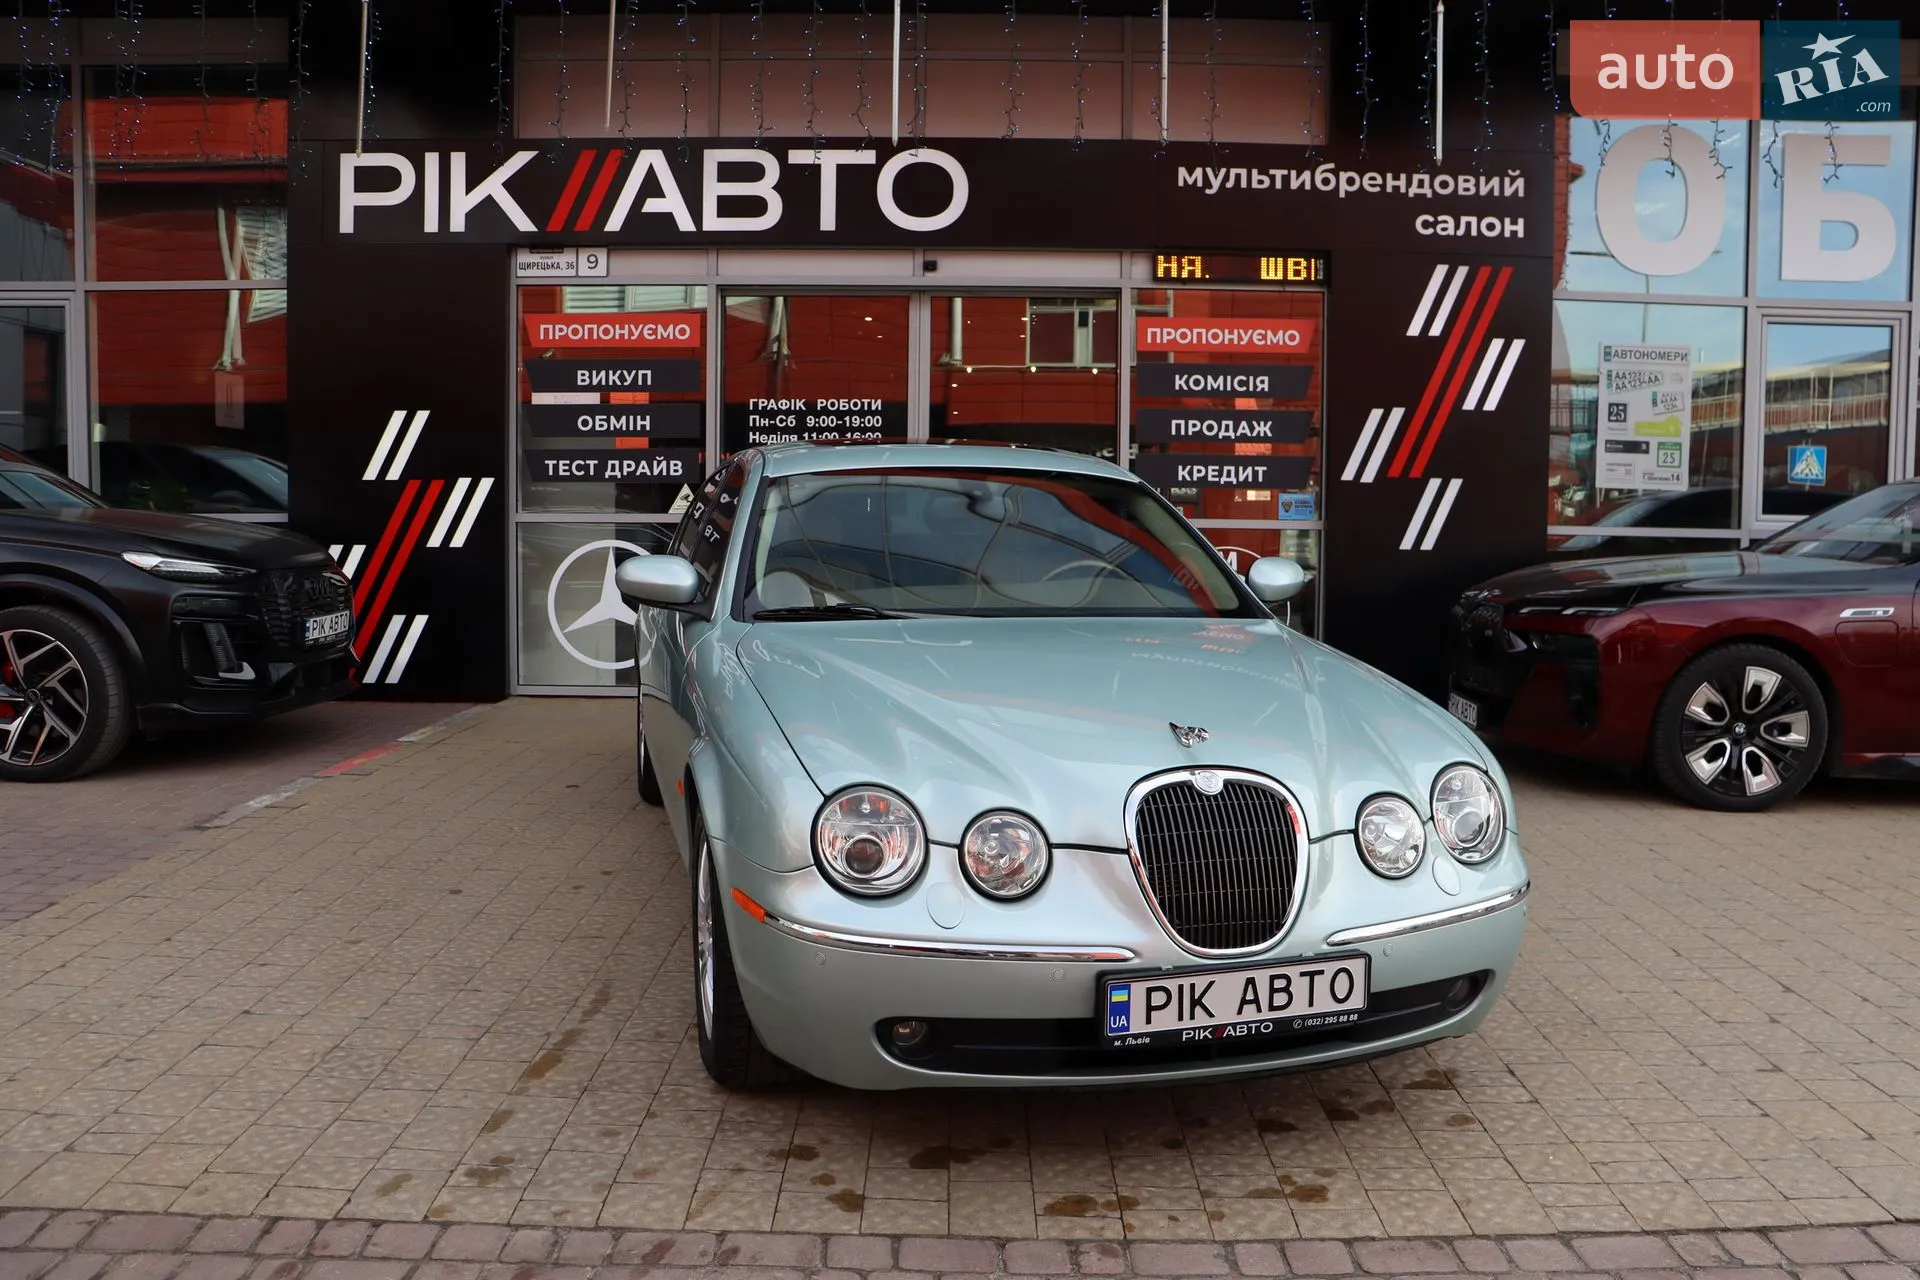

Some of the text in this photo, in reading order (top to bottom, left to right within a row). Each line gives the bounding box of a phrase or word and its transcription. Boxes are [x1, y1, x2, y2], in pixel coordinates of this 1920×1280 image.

[1177, 162, 1525, 198] мультибрендовий
[1415, 213, 1525, 239] салон
[518, 261, 575, 272] ЩИРЕЦЬКА, 36
[586, 253, 599, 270] 9
[1157, 255, 1210, 279] НЯ.
[539, 323, 691, 341] ПРОПОНУЄМО
[1146, 327, 1300, 346] ПРОПОНУЄМО
[1612, 349, 1688, 361] АВТОНОМЕРИ
[576, 369, 652, 386] ВИКУП
[1174, 374, 1269, 392] КОМІСІЯ
[749, 398, 882, 411] ГРАФІК РОБОТИ
[1610, 405, 1625, 420] 25
[577, 415, 651, 432] ОБМІН
[749, 415, 883, 428] Пн-Сб 9:00-19:00
[1171, 419, 1273, 439] ПРОДАЖ
[749, 431, 798, 445] Неділя
[1662, 452, 1676, 465] 25
[545, 456, 683, 479] ТЕСТ ДРАЙВ
[1178, 464, 1267, 485] КРЕДИТ
[1145, 966, 1355, 1026] РІК АВТО
[1110, 1015, 1128, 1028] UA
[1304, 1017, 1324, 1027] (032)
[1324, 1016, 1338, 1024] 295
[1348, 1013, 1358, 1021] 88
